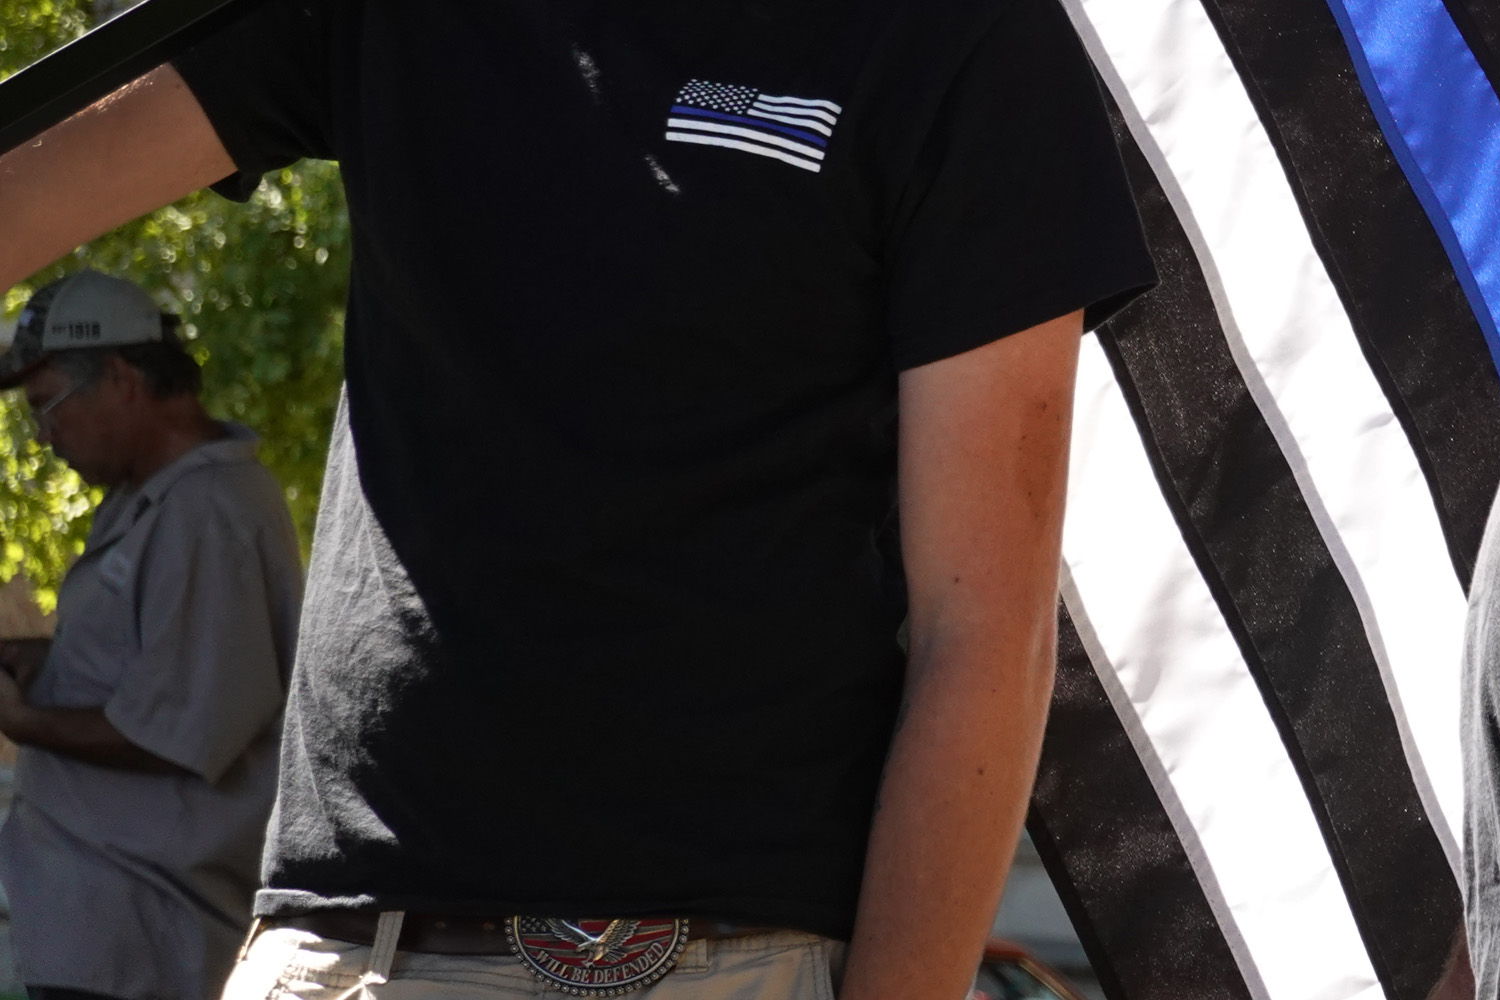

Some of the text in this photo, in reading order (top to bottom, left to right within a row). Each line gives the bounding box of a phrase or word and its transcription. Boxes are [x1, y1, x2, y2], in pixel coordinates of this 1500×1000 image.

[534, 941, 665, 984] WILL BE DEFENDED
